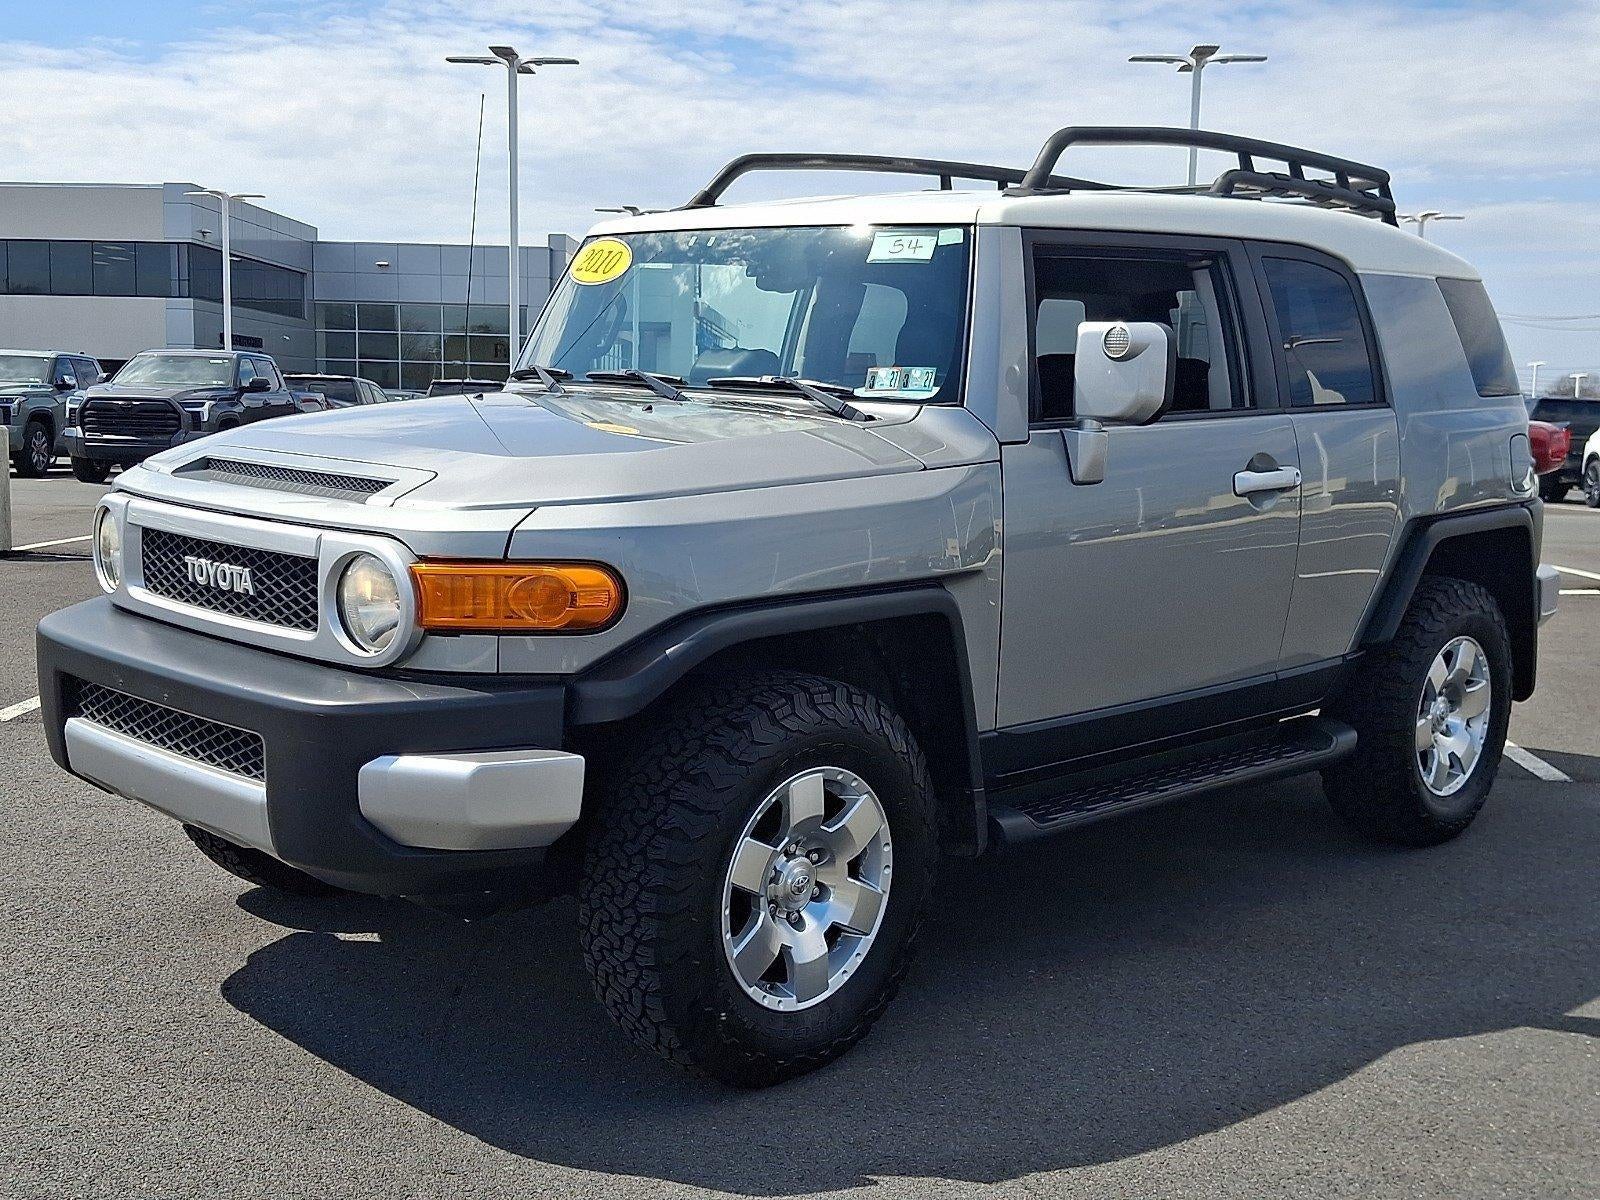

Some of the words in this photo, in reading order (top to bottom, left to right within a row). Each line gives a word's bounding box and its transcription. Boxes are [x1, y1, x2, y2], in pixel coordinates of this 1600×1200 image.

[888, 238, 923, 254] 54
[575, 248, 623, 275] 2010
[868, 375, 876, 389] 3
[902, 373, 910, 388] 3
[184, 555, 256, 596] TOYOTA
